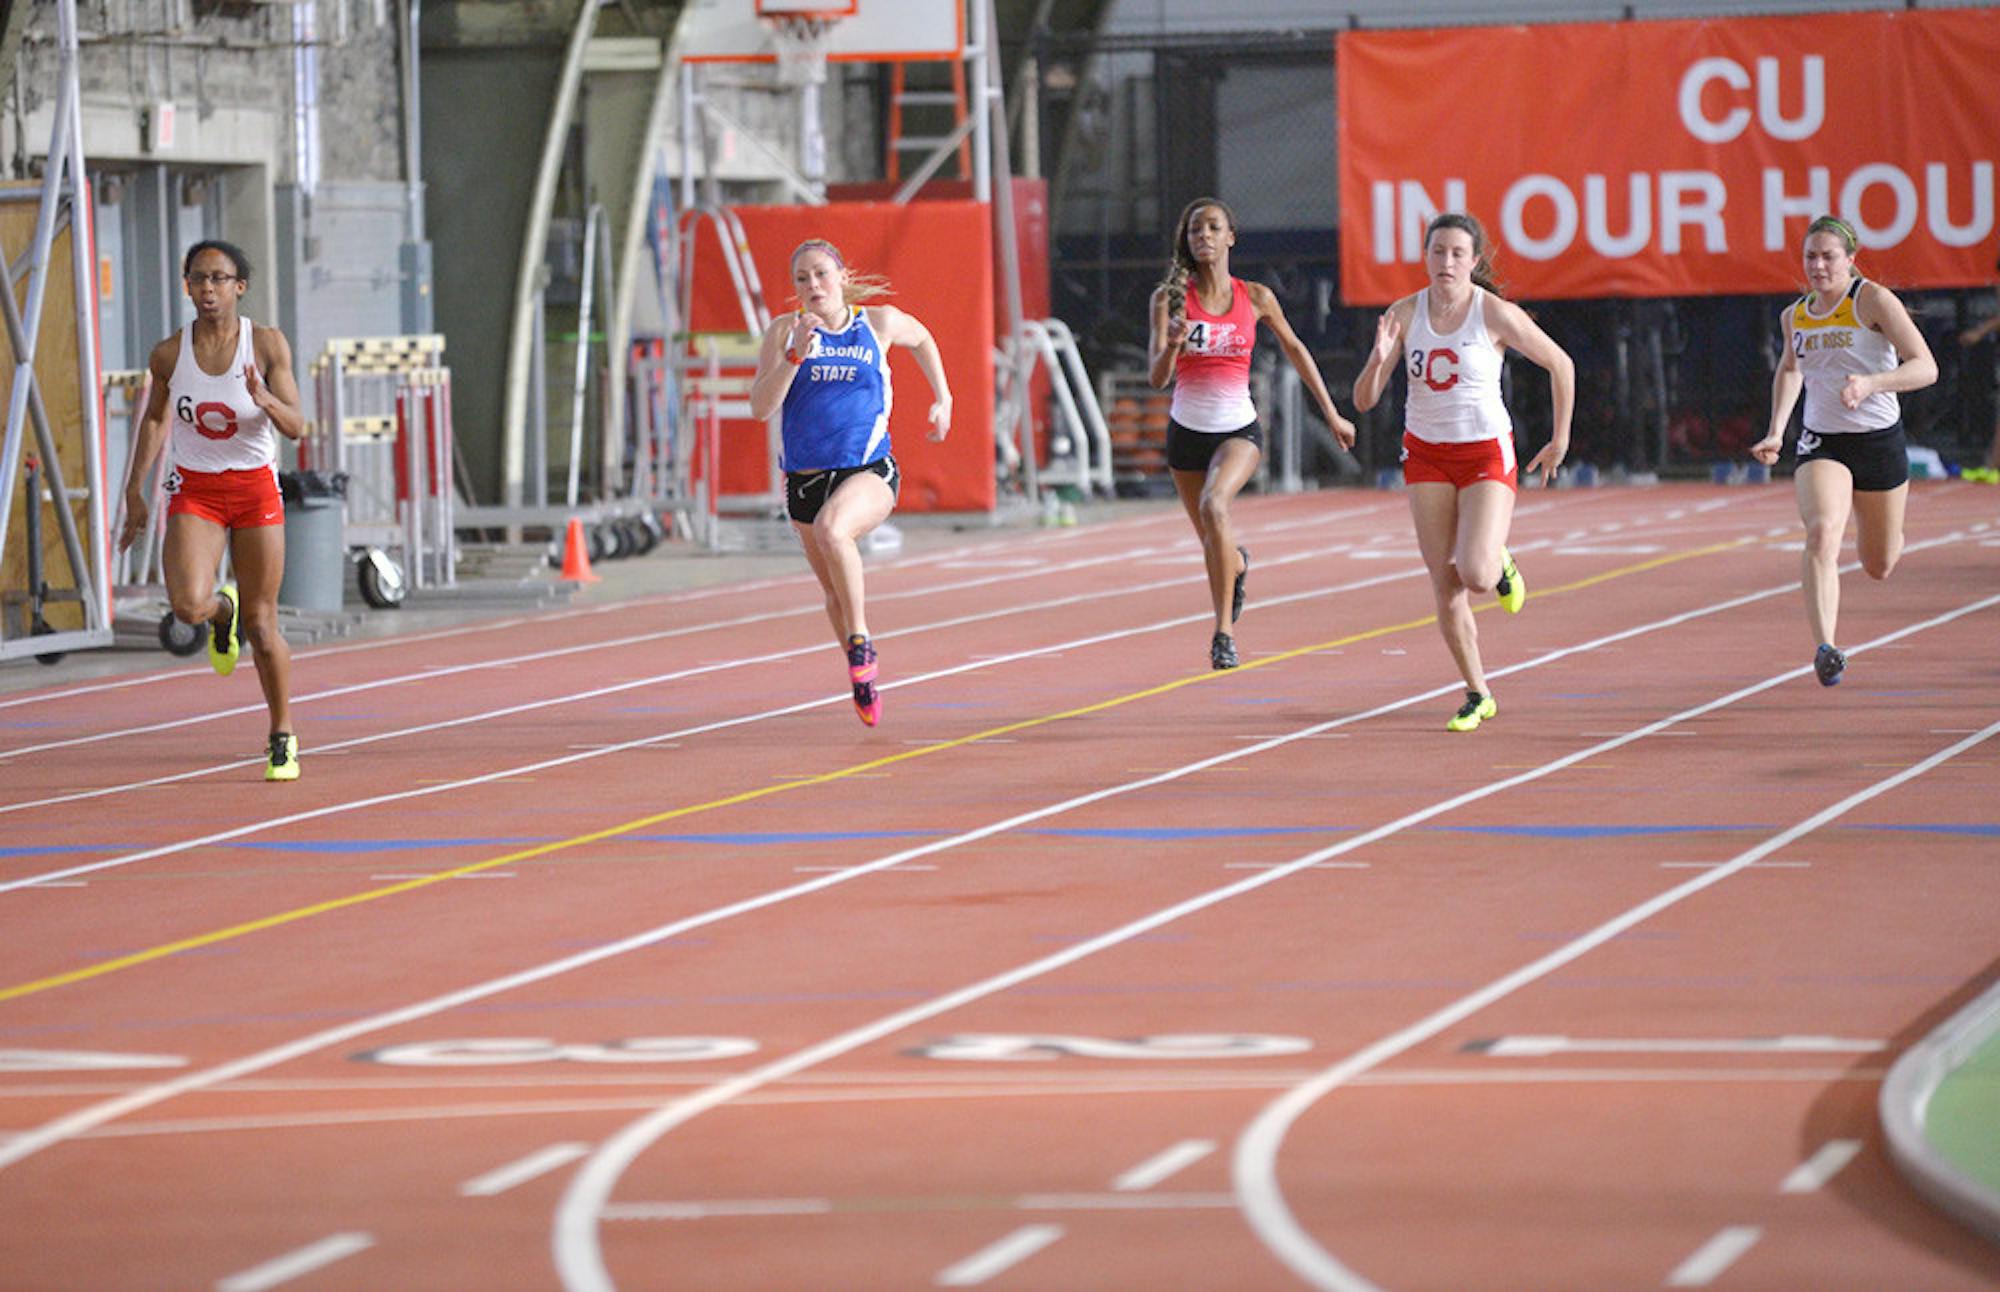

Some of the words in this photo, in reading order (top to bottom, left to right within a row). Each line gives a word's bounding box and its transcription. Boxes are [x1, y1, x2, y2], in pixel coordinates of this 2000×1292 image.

[1679, 55, 1825, 144] CU
[1372, 178, 1467, 264] IN
[1501, 171, 1729, 261] OUR
[1188, 323, 1205, 348] 4
[1794, 331, 1805, 358] 2
[1823, 331, 1854, 349] ROSE
[816, 345, 874, 365] EDONIA
[1411, 349, 1424, 378] 3
[811, 365, 858, 382] STATE
[1425, 348, 1459, 392] C
[177, 395, 193, 423] 6
[195, 401, 238, 440] C
